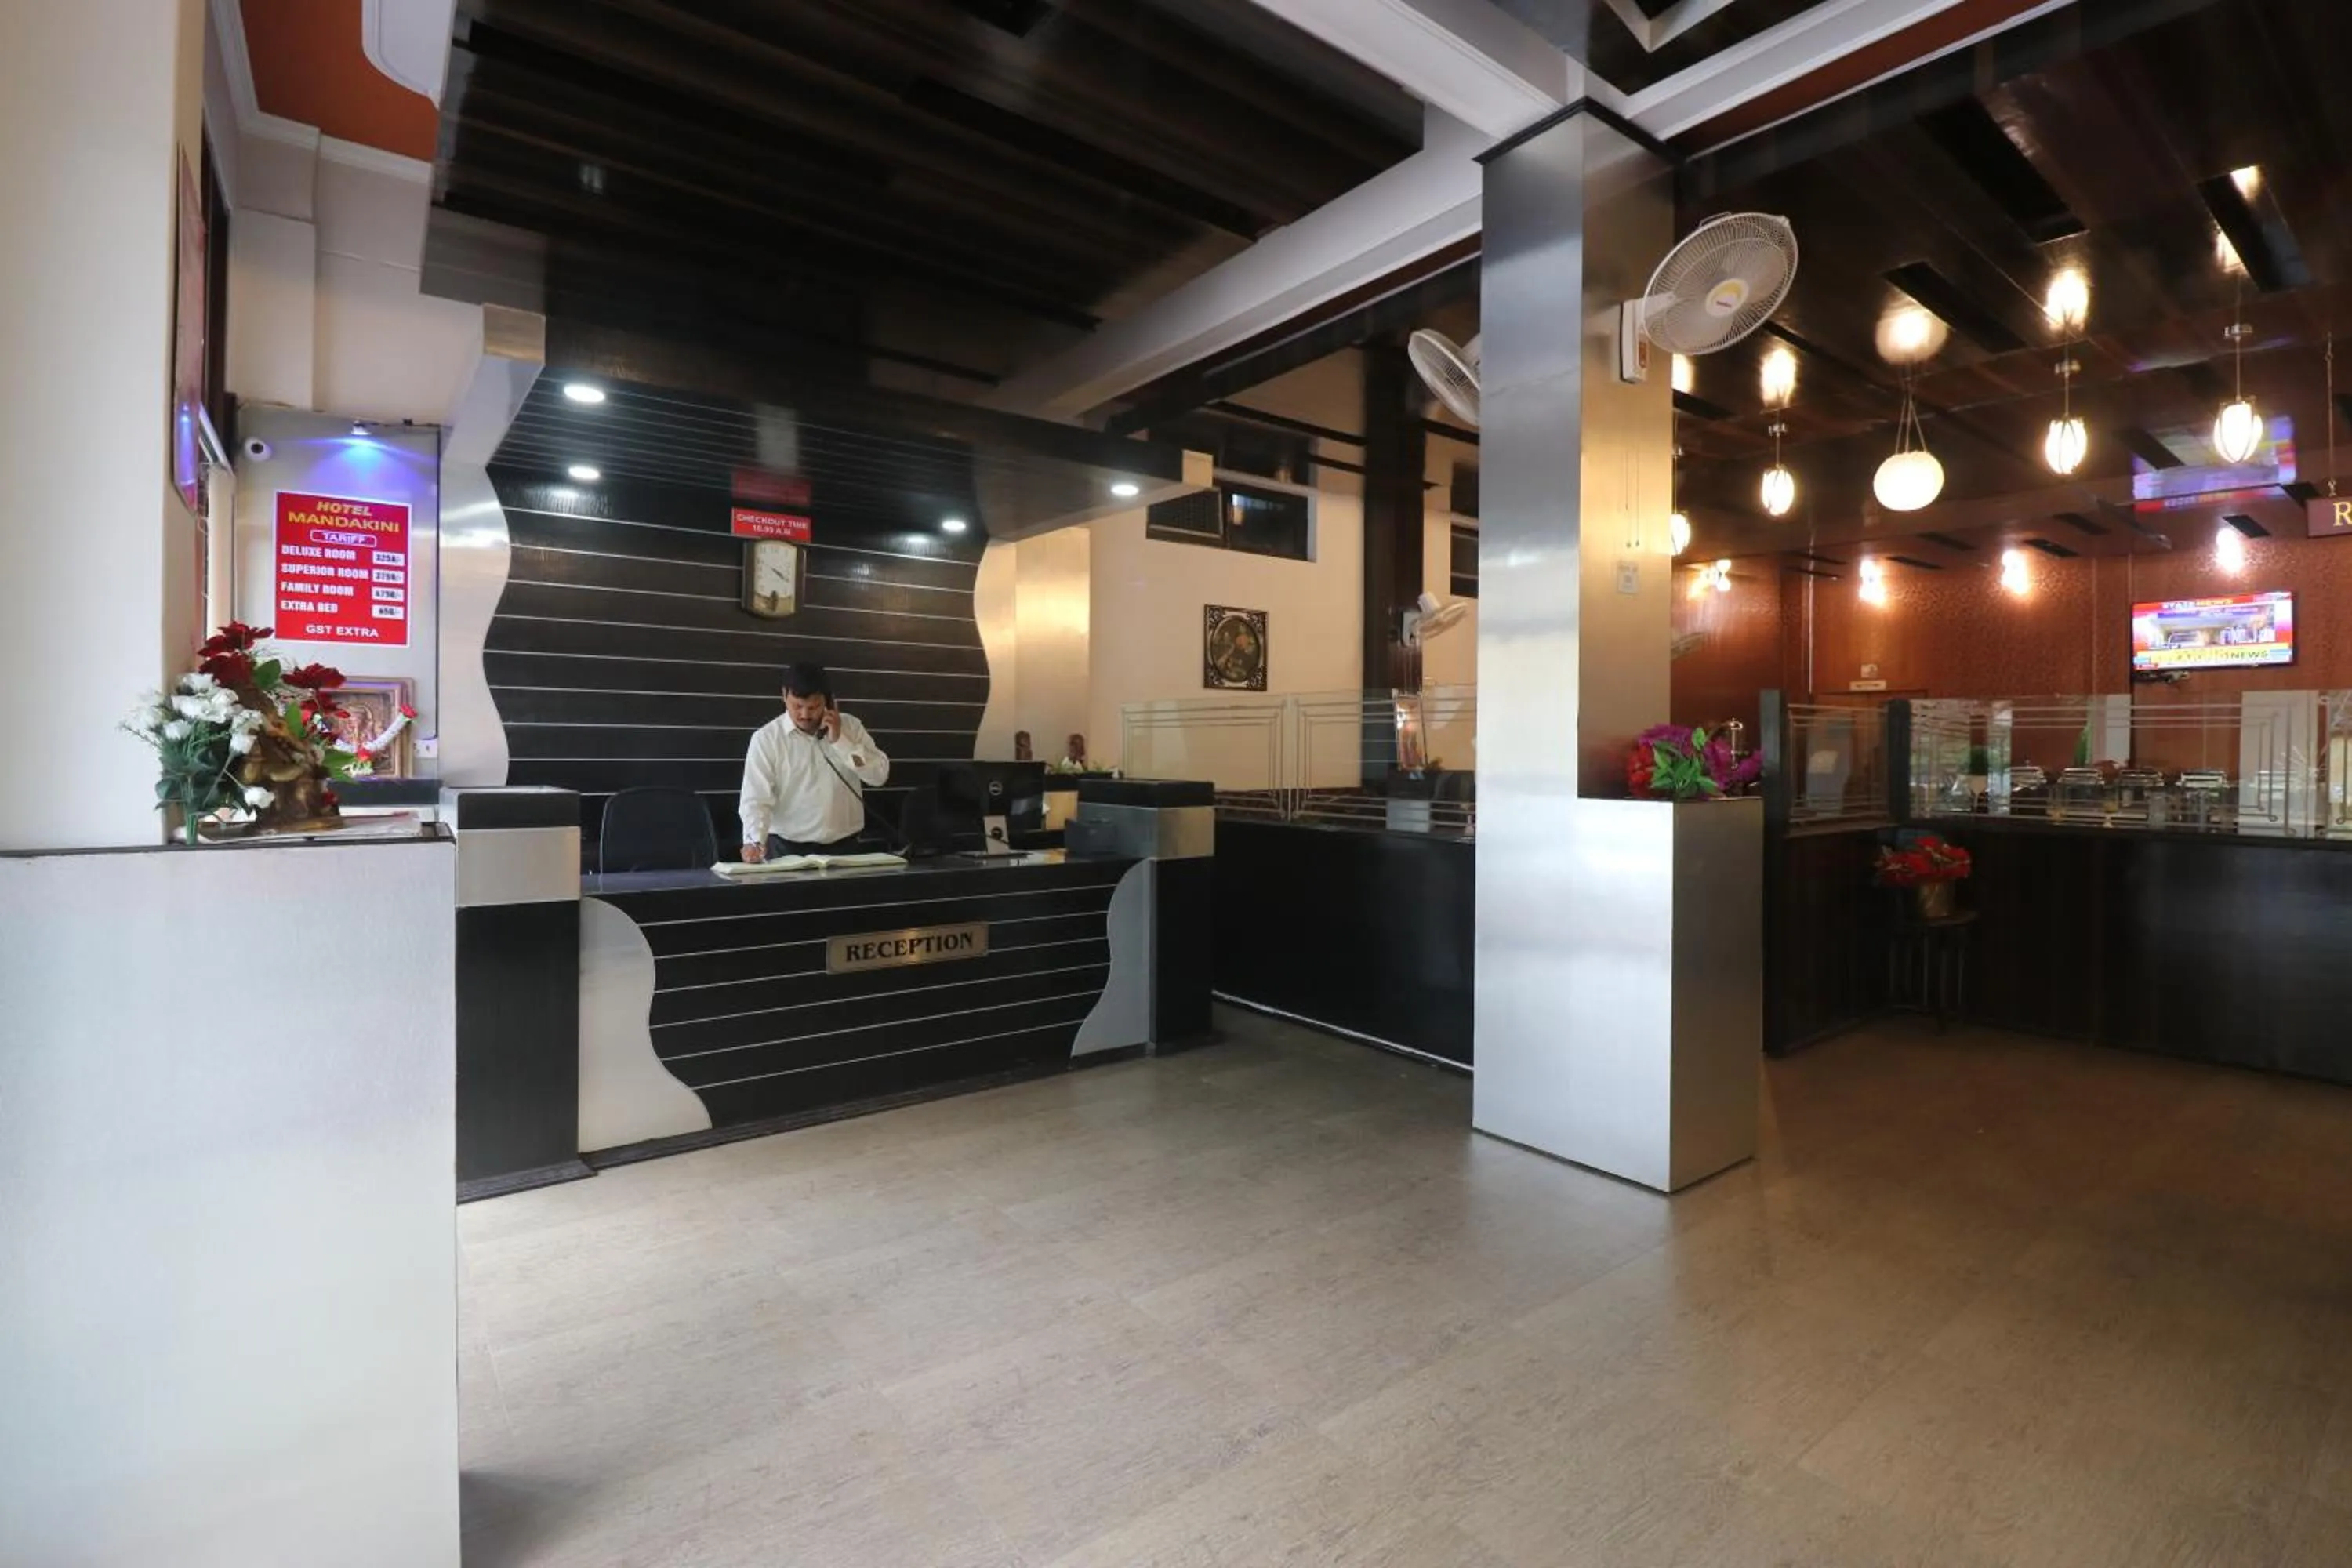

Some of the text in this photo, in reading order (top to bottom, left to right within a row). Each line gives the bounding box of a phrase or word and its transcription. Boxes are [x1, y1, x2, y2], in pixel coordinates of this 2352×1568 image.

[317, 501, 372, 516] HOTEL
[289, 512, 400, 532] MANDAKINI
[737, 514, 786, 526] CHECKOUT
[323, 533, 366, 543] TARIFF
[281, 544, 357, 561] DELUXE ROOM
[281, 563, 370, 580] SUPERIOR ROOM
[281, 581, 354, 597] FAMILY ROOM
[281, 600, 339, 614] EXTRA BED
[305, 625, 379, 638] GST EXTRA
[846, 932, 973, 962] RECEPTION
